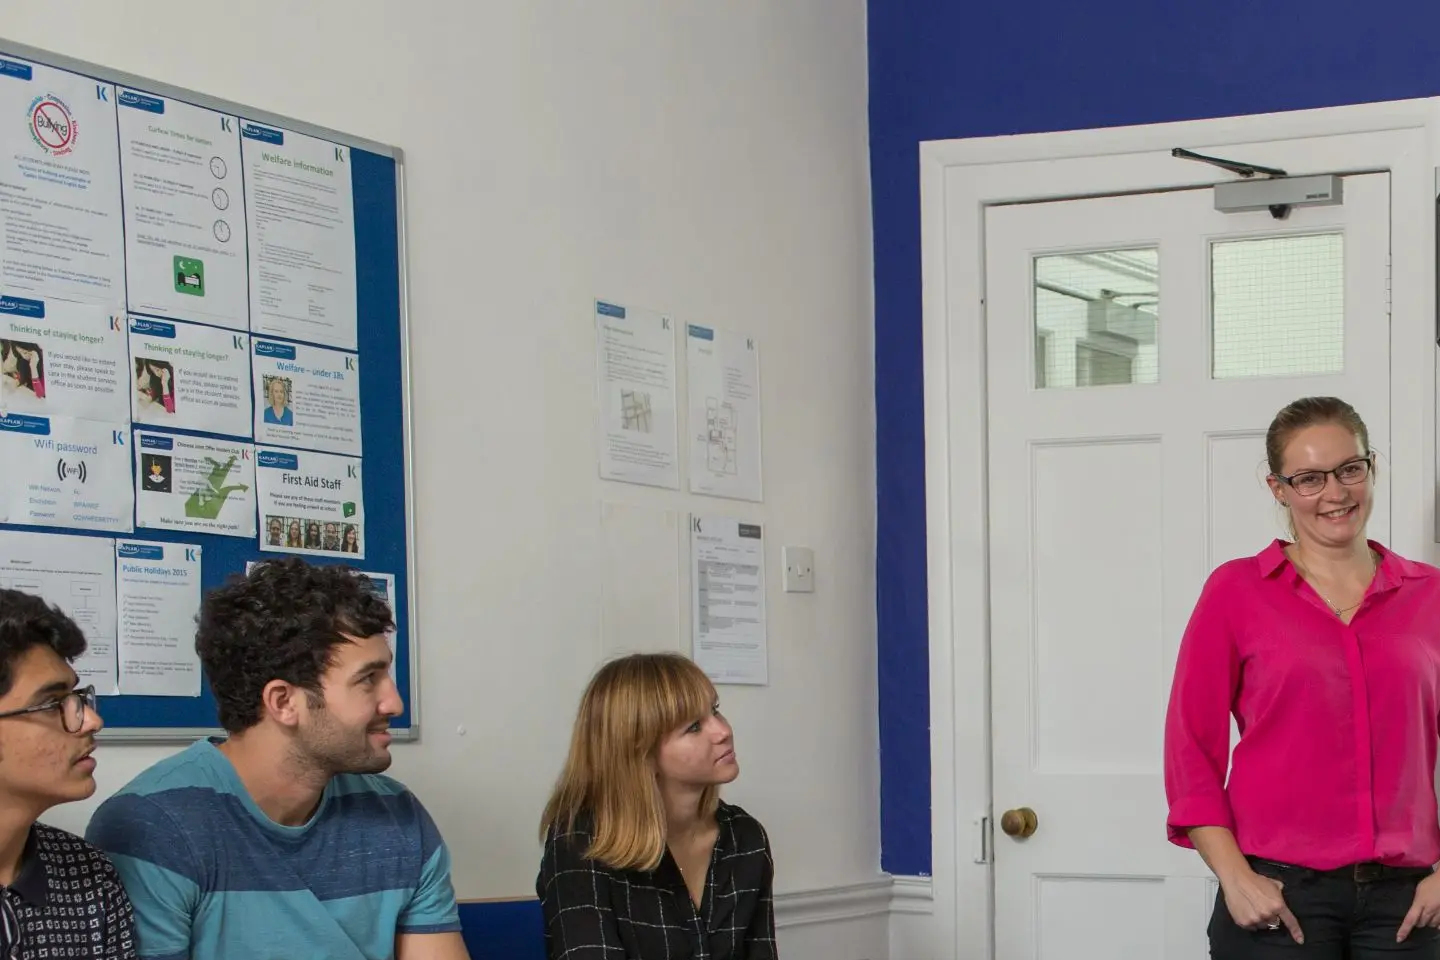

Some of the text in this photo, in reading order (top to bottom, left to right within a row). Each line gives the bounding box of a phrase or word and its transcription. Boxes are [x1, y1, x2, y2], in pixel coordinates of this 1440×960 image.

[38, 116, 68, 136] Bullying
[262, 151, 292, 166] Welfare
[10, 324, 42, 336] Thinking
[53, 331, 77, 341] staying
[79, 332, 104, 344] longer?
[144, 343, 172, 355] Thinking
[183, 349, 205, 360] staying
[206, 351, 229, 362] longer?
[276, 361, 305, 373] Welfare
[313, 369, 331, 379] under
[34, 439, 97, 454] Wifi password
[282, 473, 341, 490] First Aid Staff
[122, 565, 142, 574] Public
[144, 566, 172, 577] Holidays
